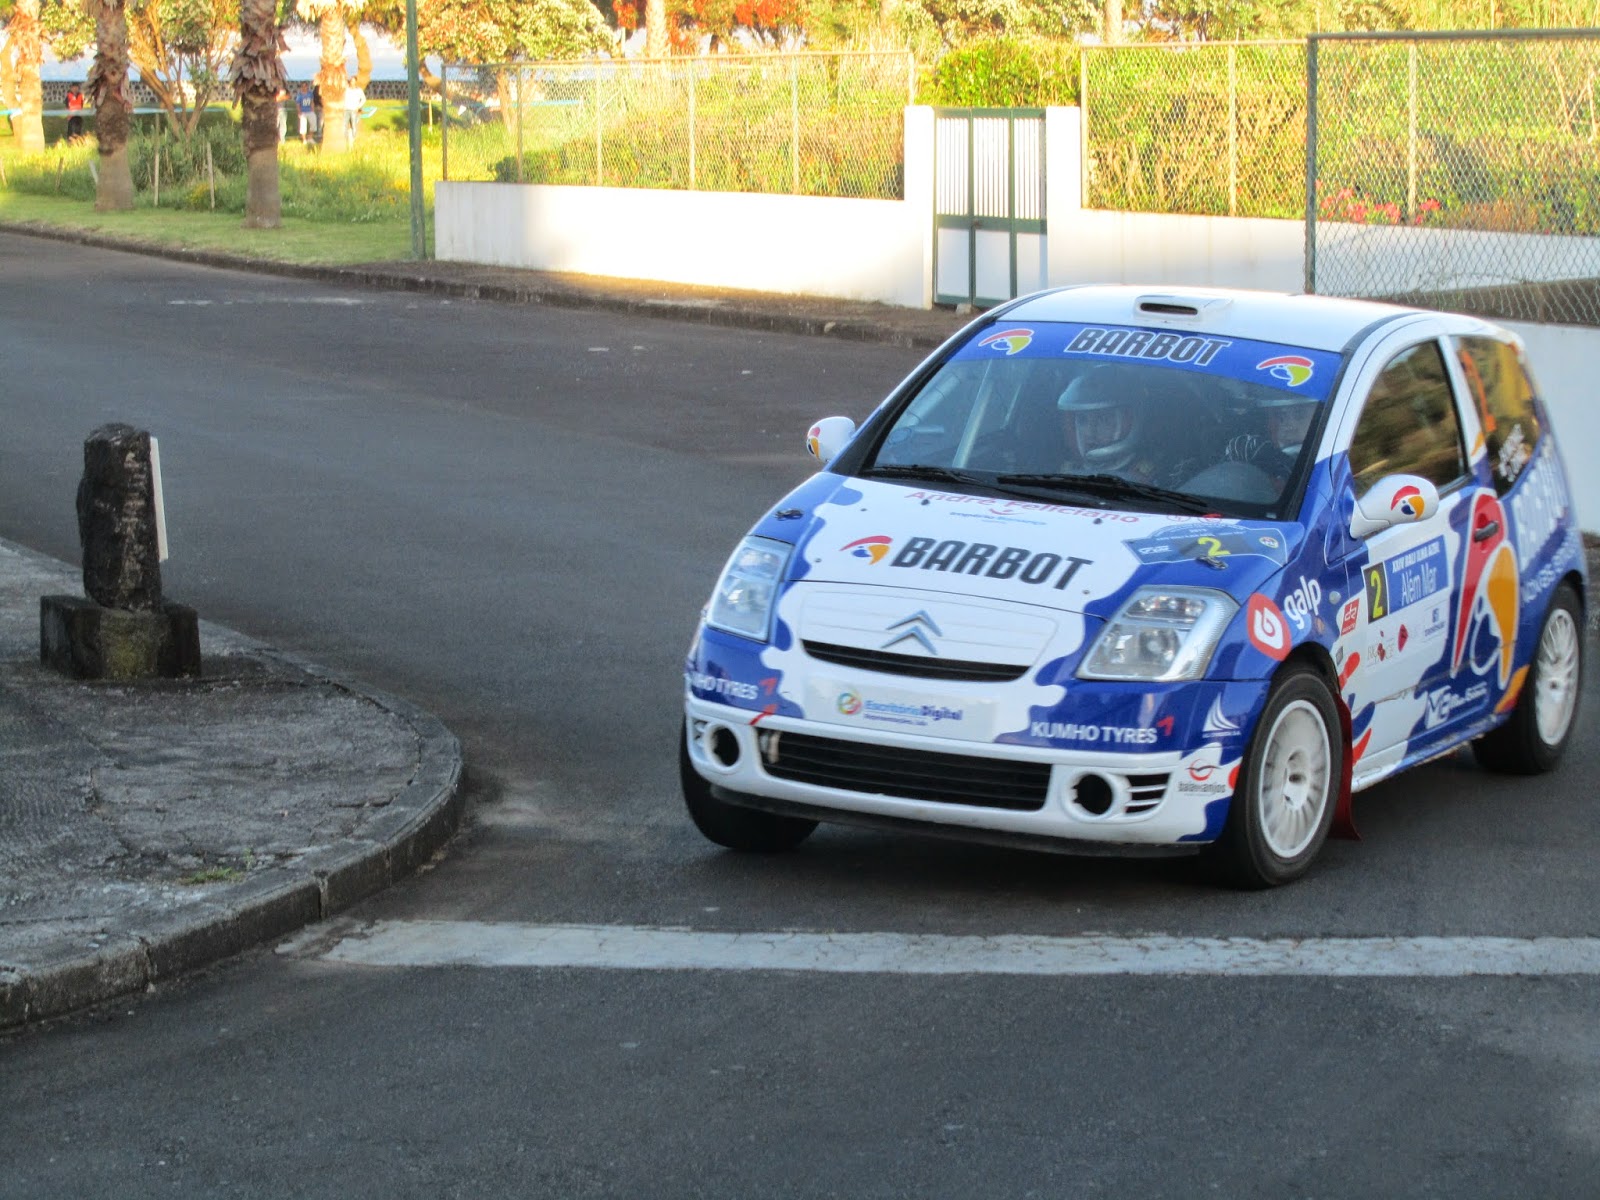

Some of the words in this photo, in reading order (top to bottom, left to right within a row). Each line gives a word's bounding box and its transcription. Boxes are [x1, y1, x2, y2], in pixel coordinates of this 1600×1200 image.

[1064, 328, 1232, 366] BARBOT
[1003, 501, 1140, 523] Feliciano
[890, 536, 1094, 590] BARBOT
[1197, 536, 1231, 556] 2
[1371, 570, 1383, 618] 2
[1421, 562, 1437, 597] Mar
[1284, 575, 1321, 629] galp
[716, 677, 759, 699] TYRES
[1031, 721, 1099, 741] KUMHO
[1100, 726, 1158, 743] TYRES
